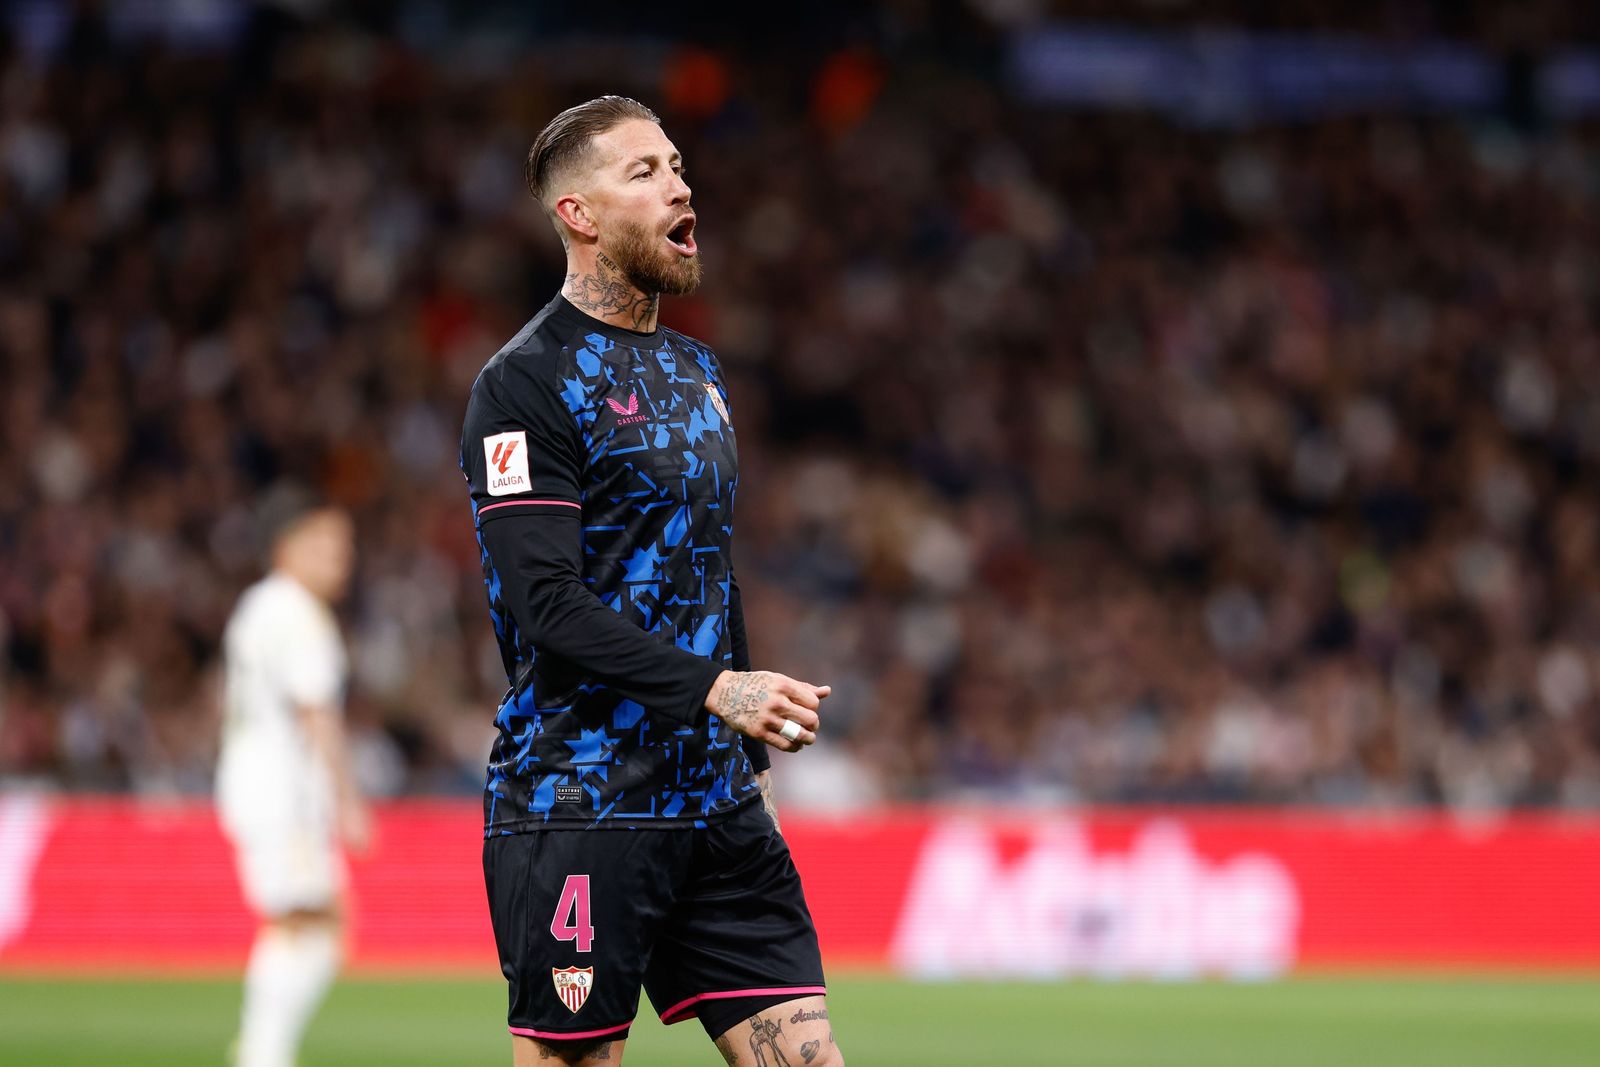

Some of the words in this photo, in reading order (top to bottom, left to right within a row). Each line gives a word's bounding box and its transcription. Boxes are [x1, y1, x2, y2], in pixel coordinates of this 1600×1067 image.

[617, 415, 647, 426] CASTORE
[492, 475, 524, 488] LALIGA
[550, 874, 594, 952] 4
